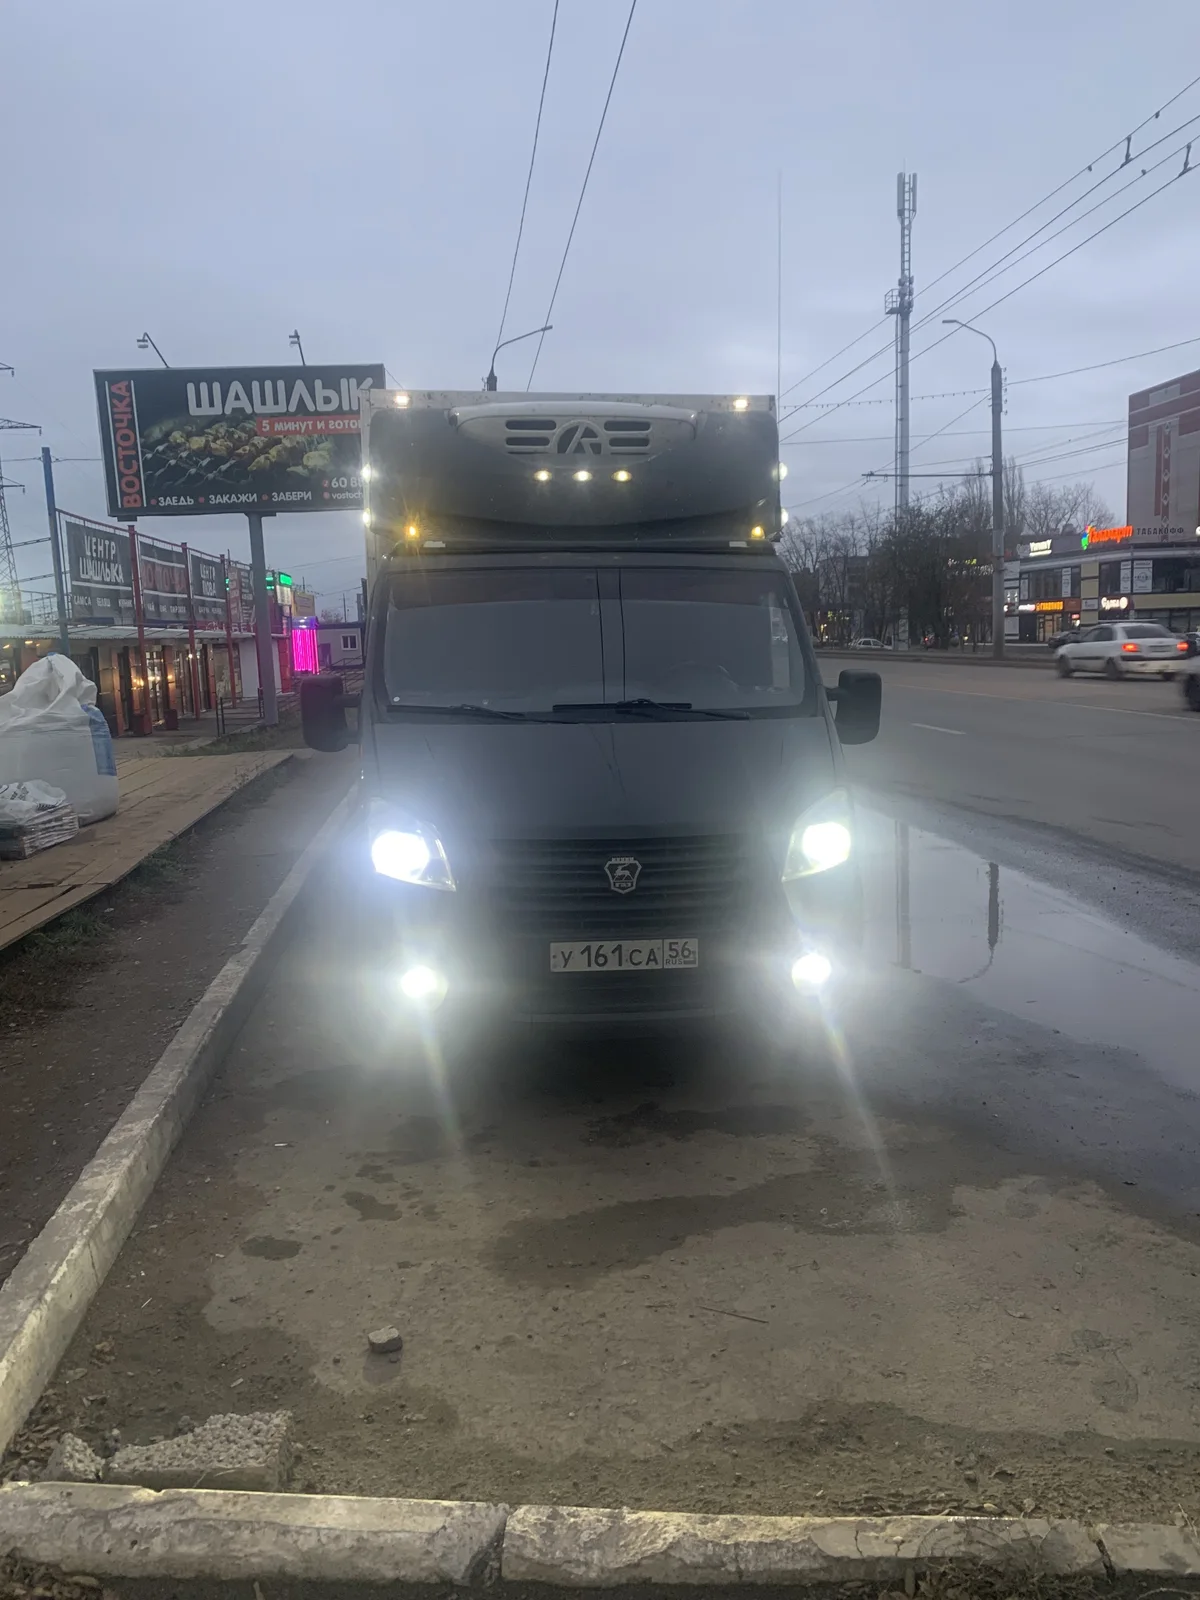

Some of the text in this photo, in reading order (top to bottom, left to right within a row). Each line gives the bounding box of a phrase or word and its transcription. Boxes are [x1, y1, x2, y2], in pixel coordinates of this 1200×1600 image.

[186, 377, 373, 416] ШАШЛЫК
[261, 419, 361, 433] 5 минут и гото
[110, 380, 142, 508] ВОСТОЧКА
[331, 477, 348, 488] 60
[158, 491, 312, 507] ЗАЕДЬ ЗАКАЖИ ЗАБЕРИ
[1136, 527, 1184, 536] ТАБАКОФФ
[84, 535, 116, 560] ЦЕНТР
[79, 557, 124, 583] ШАШЛЫКА
[668, 941, 692, 959] 56
[665, 958, 683, 966] RUS
